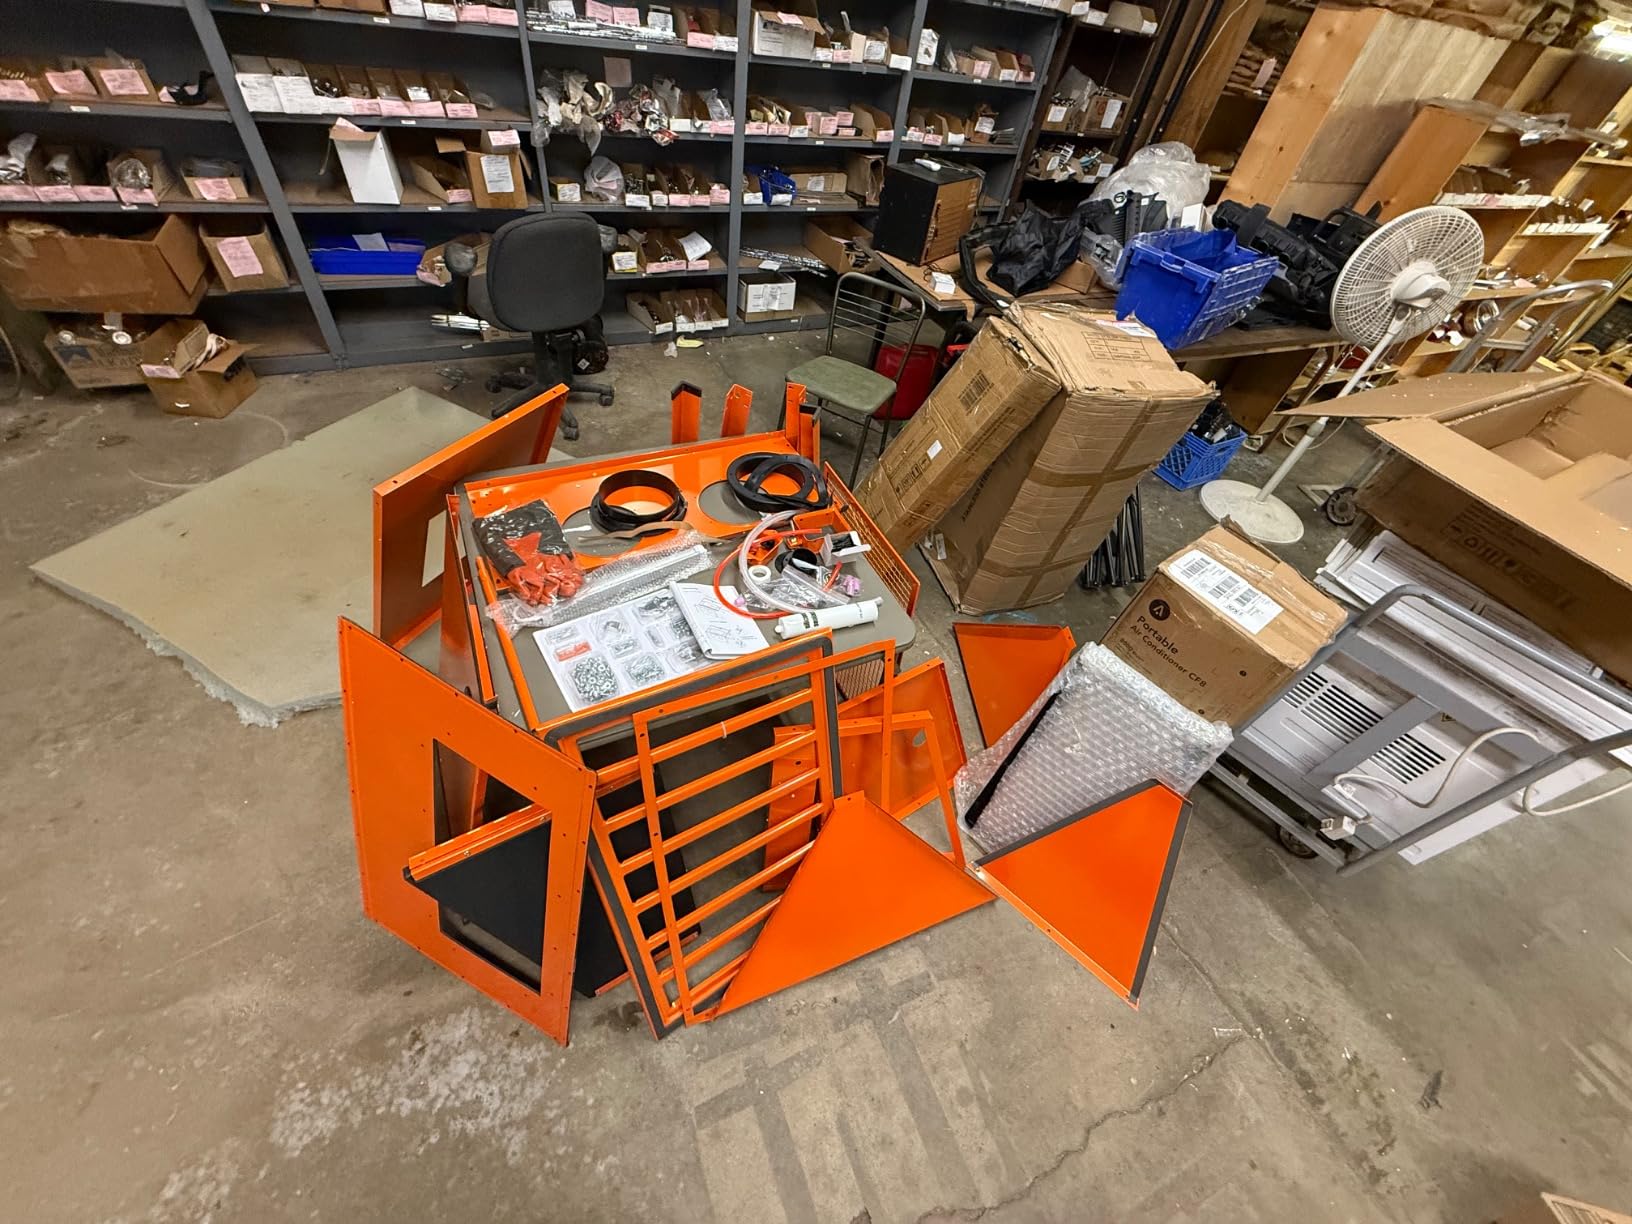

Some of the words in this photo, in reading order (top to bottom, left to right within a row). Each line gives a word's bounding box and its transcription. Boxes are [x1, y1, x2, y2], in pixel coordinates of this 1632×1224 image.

[1130, 625, 1143, 636] Air
[1142, 635, 1188, 673] Conditioner
[1188, 672, 1207, 688] CF8
[1136, 615, 1179, 655] Portable
